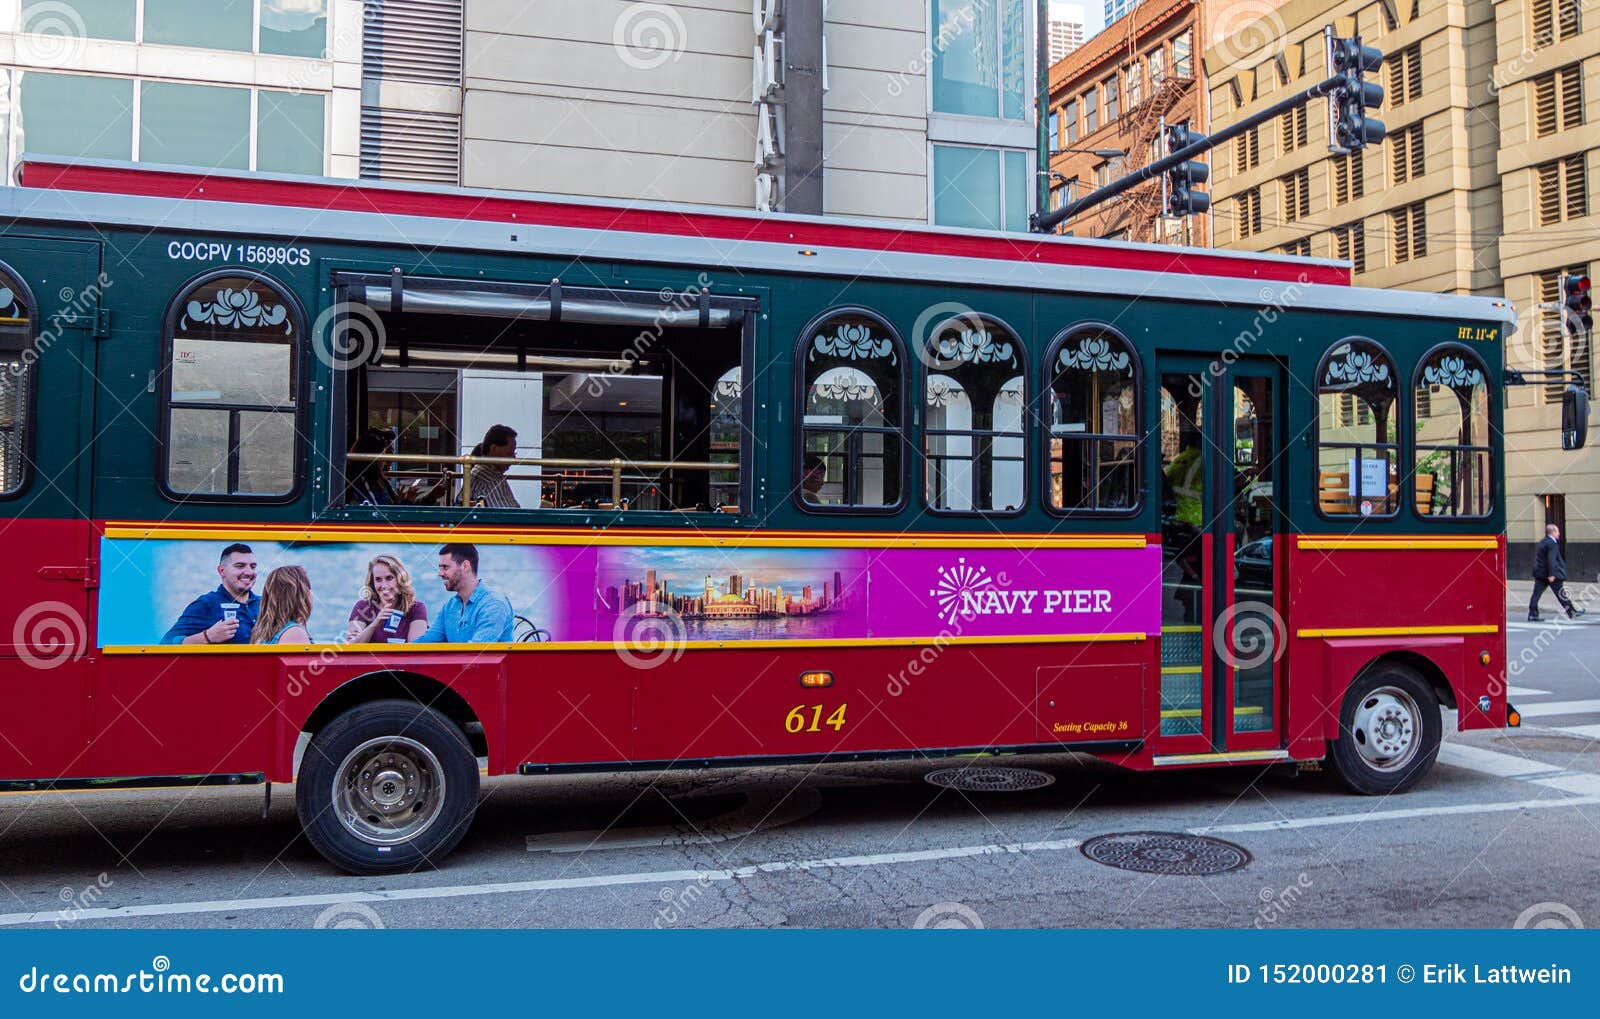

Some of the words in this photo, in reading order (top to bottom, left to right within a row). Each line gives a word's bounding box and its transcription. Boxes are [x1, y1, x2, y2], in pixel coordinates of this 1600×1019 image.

[167, 241, 232, 261] COCPV
[237, 245, 310, 266] 15699CS
[1458, 327, 1473, 339] HT.
[959, 590, 1038, 615] NAVY
[1043, 590, 1112, 613] PIER
[785, 703, 847, 733] 614
[1053, 722, 1081, 734] Seating
[1083, 721, 1116, 734] Capacity
[1118, 720, 1128, 731] 36
